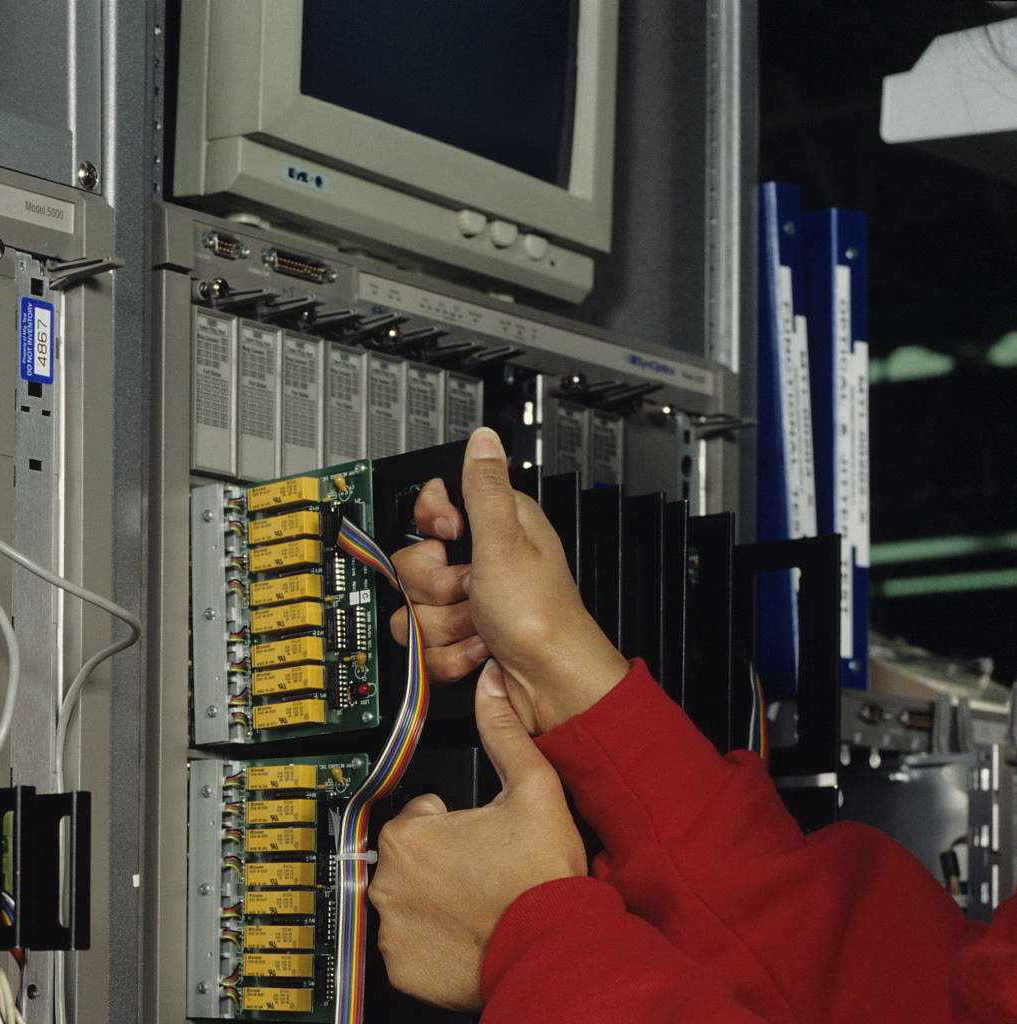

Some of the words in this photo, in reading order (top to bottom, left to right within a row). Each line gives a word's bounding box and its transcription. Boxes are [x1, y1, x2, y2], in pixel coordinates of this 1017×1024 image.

[25, 201, 45, 215] Model
[47, 206, 63, 220] 5000
[38, 319, 47, 367] 4867
[27, 364, 32, 376] DO
